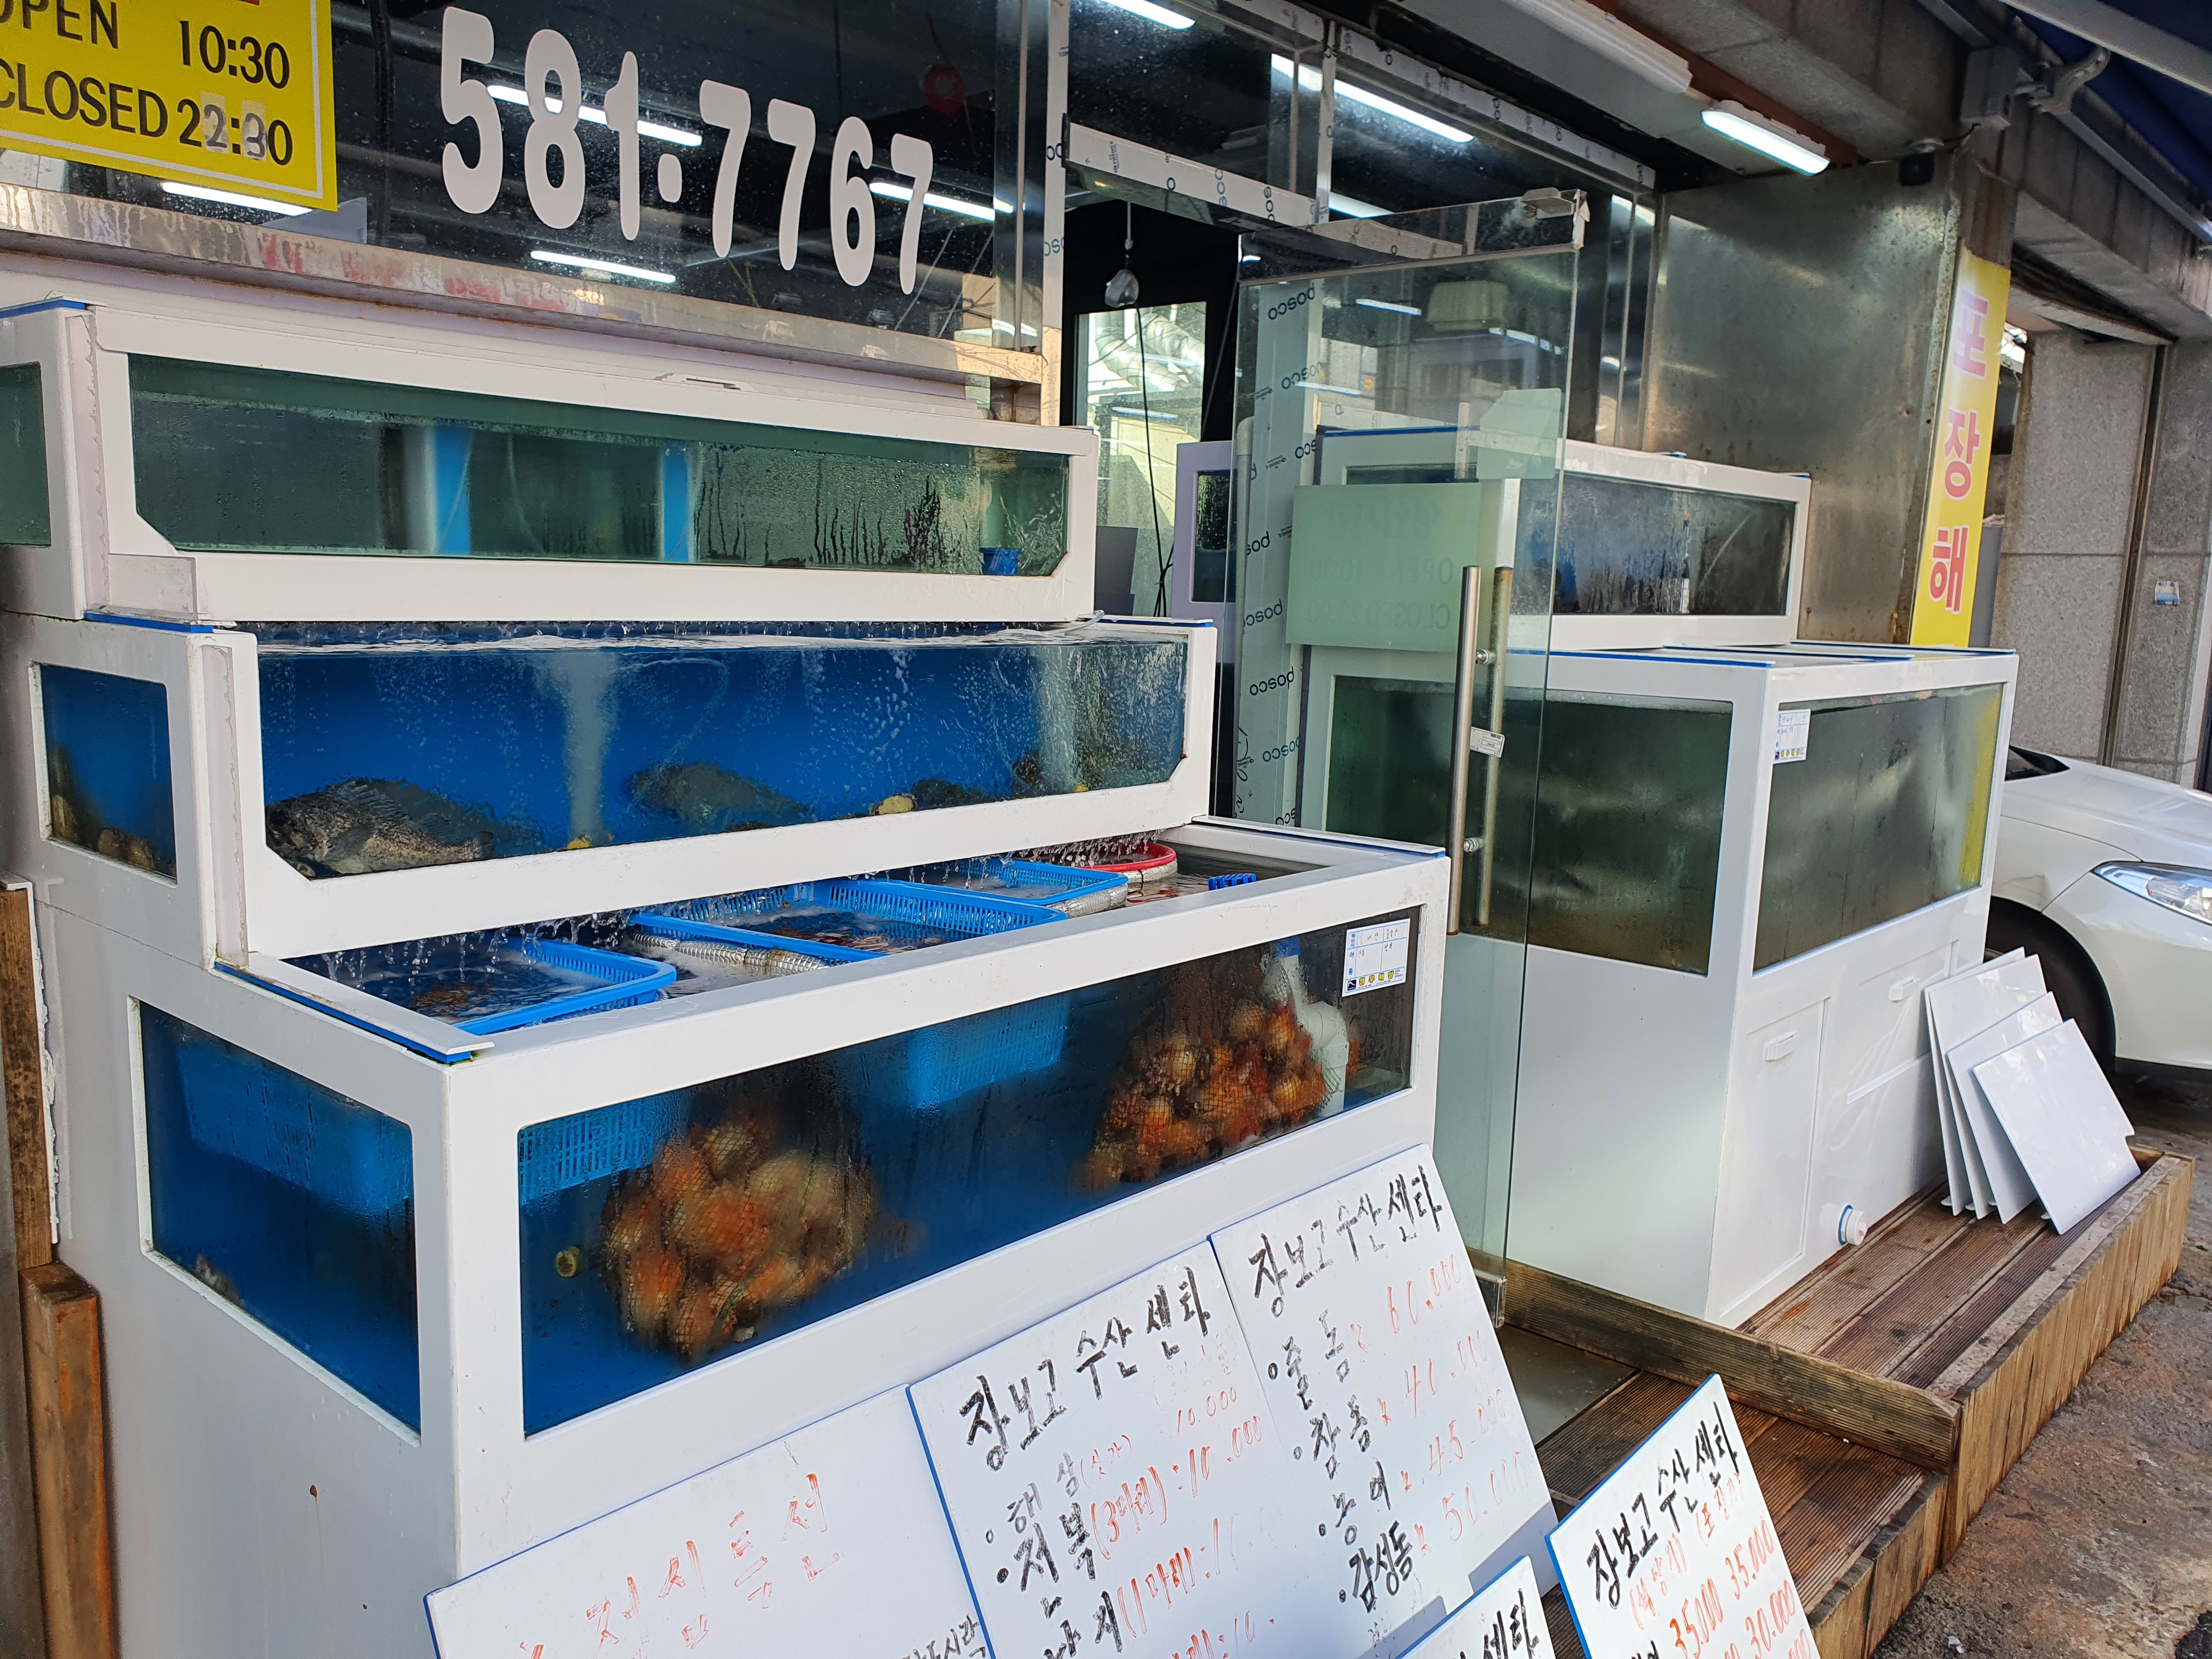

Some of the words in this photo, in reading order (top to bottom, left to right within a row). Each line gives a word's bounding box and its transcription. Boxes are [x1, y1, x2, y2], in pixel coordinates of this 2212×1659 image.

[179, 20, 290, 89] 10:30
[177, 98, 293, 166] 22:30
[1244, 599, 1283, 628] posc
